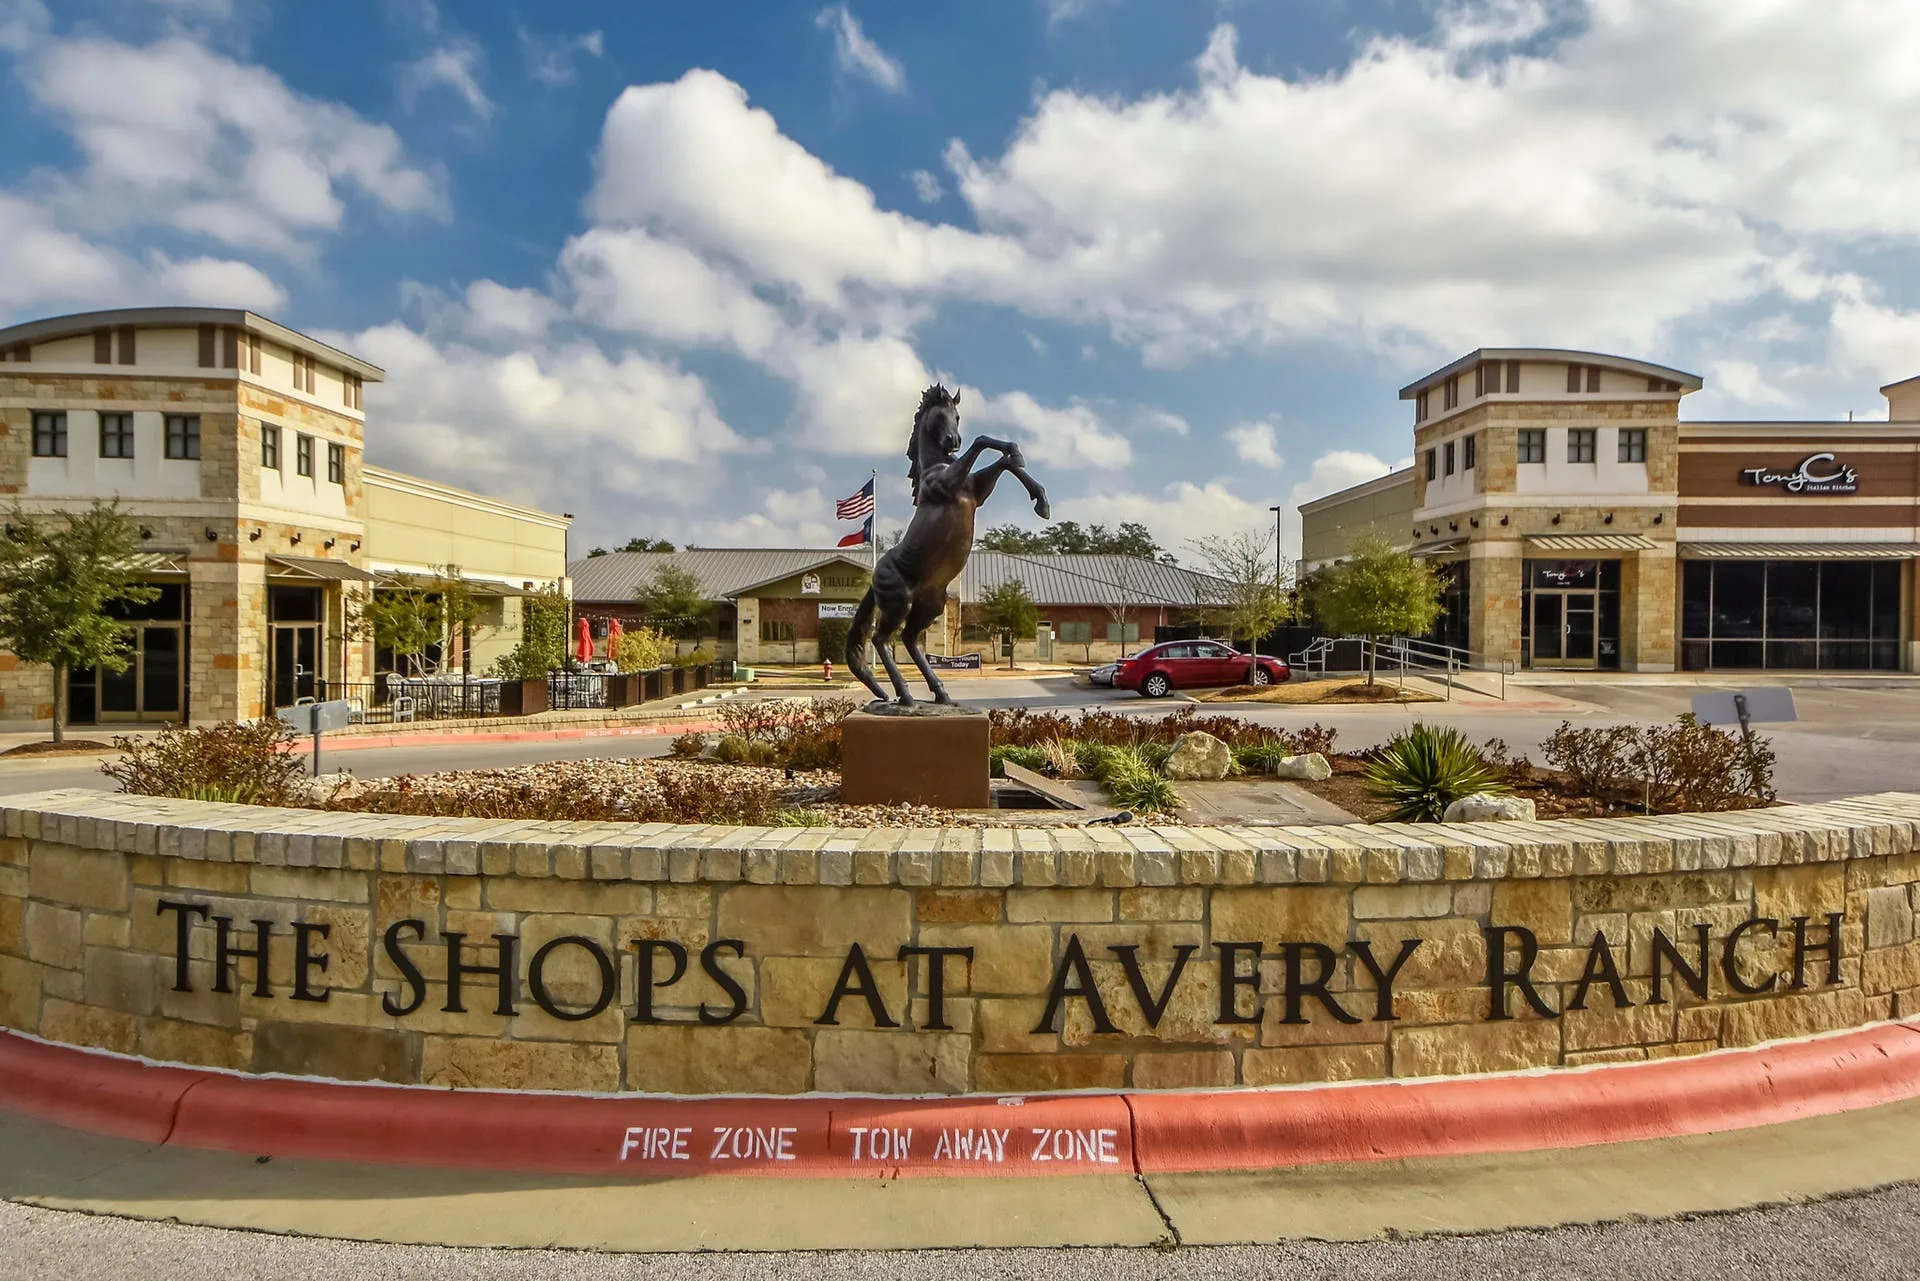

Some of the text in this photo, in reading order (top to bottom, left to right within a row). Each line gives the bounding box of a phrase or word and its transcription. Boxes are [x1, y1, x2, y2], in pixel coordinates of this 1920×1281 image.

[950, 661, 969, 669] Today
[157, 899, 1844, 1034] THE SHOPS AT AVERY RANCH
[619, 1127, 1120, 1164] FIRE ZONE TOW AWAY ZONE
